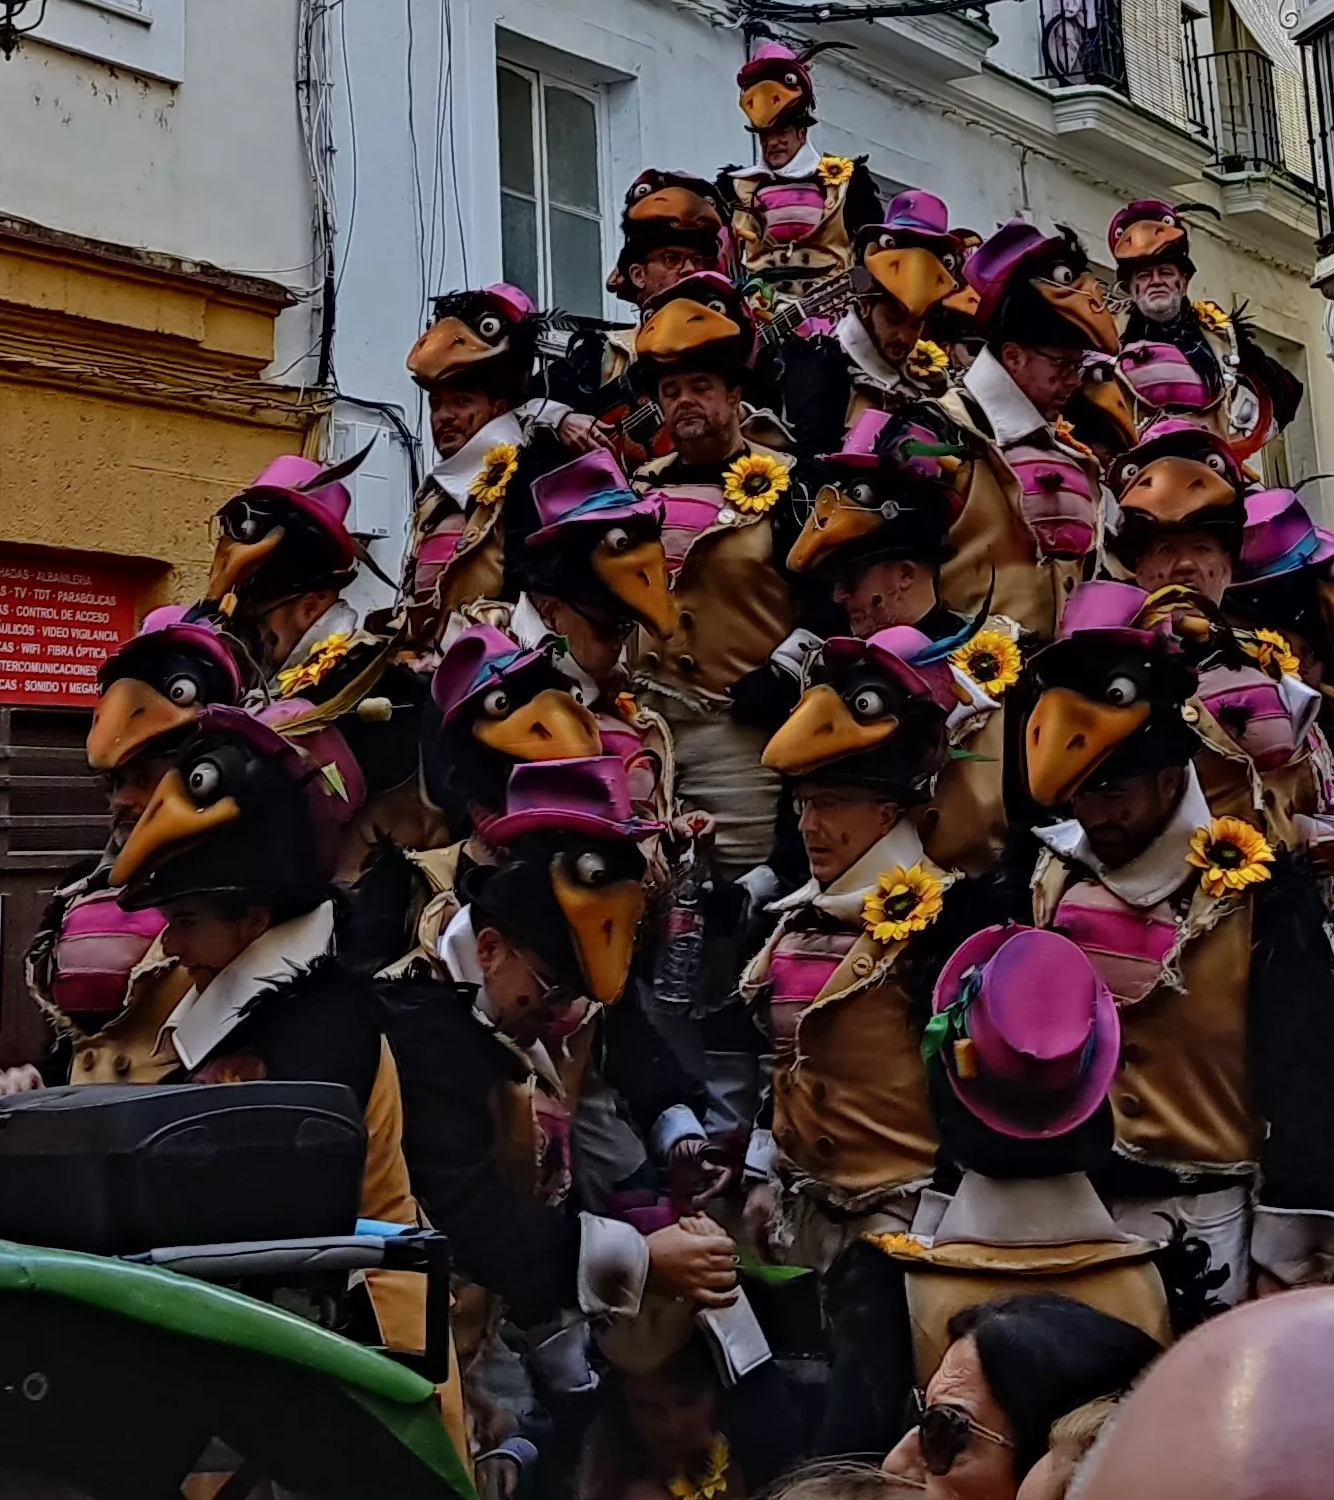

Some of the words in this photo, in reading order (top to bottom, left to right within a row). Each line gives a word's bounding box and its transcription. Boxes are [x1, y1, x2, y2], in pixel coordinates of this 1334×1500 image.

[14, 587, 27, 598] TV
[34, 589, 52, 600] TDT
[57, 590, 116, 606] PARABÓLICAS
[16, 605, 59, 619] CONTROL
[61, 609, 73, 620] DE
[75, 610, 109, 623] ACCESO
[42, 626, 69, 638] VIDEO
[71, 628, 119, 642] VIGILANCIA
[21, 643, 40, 655] WIFI
[47, 644, 74, 657] FIBRA
[76, 644, 107, 659] ÓPTICA
[24, 680, 59, 692] SONIDO
[61, 683, 67, 693] Y
